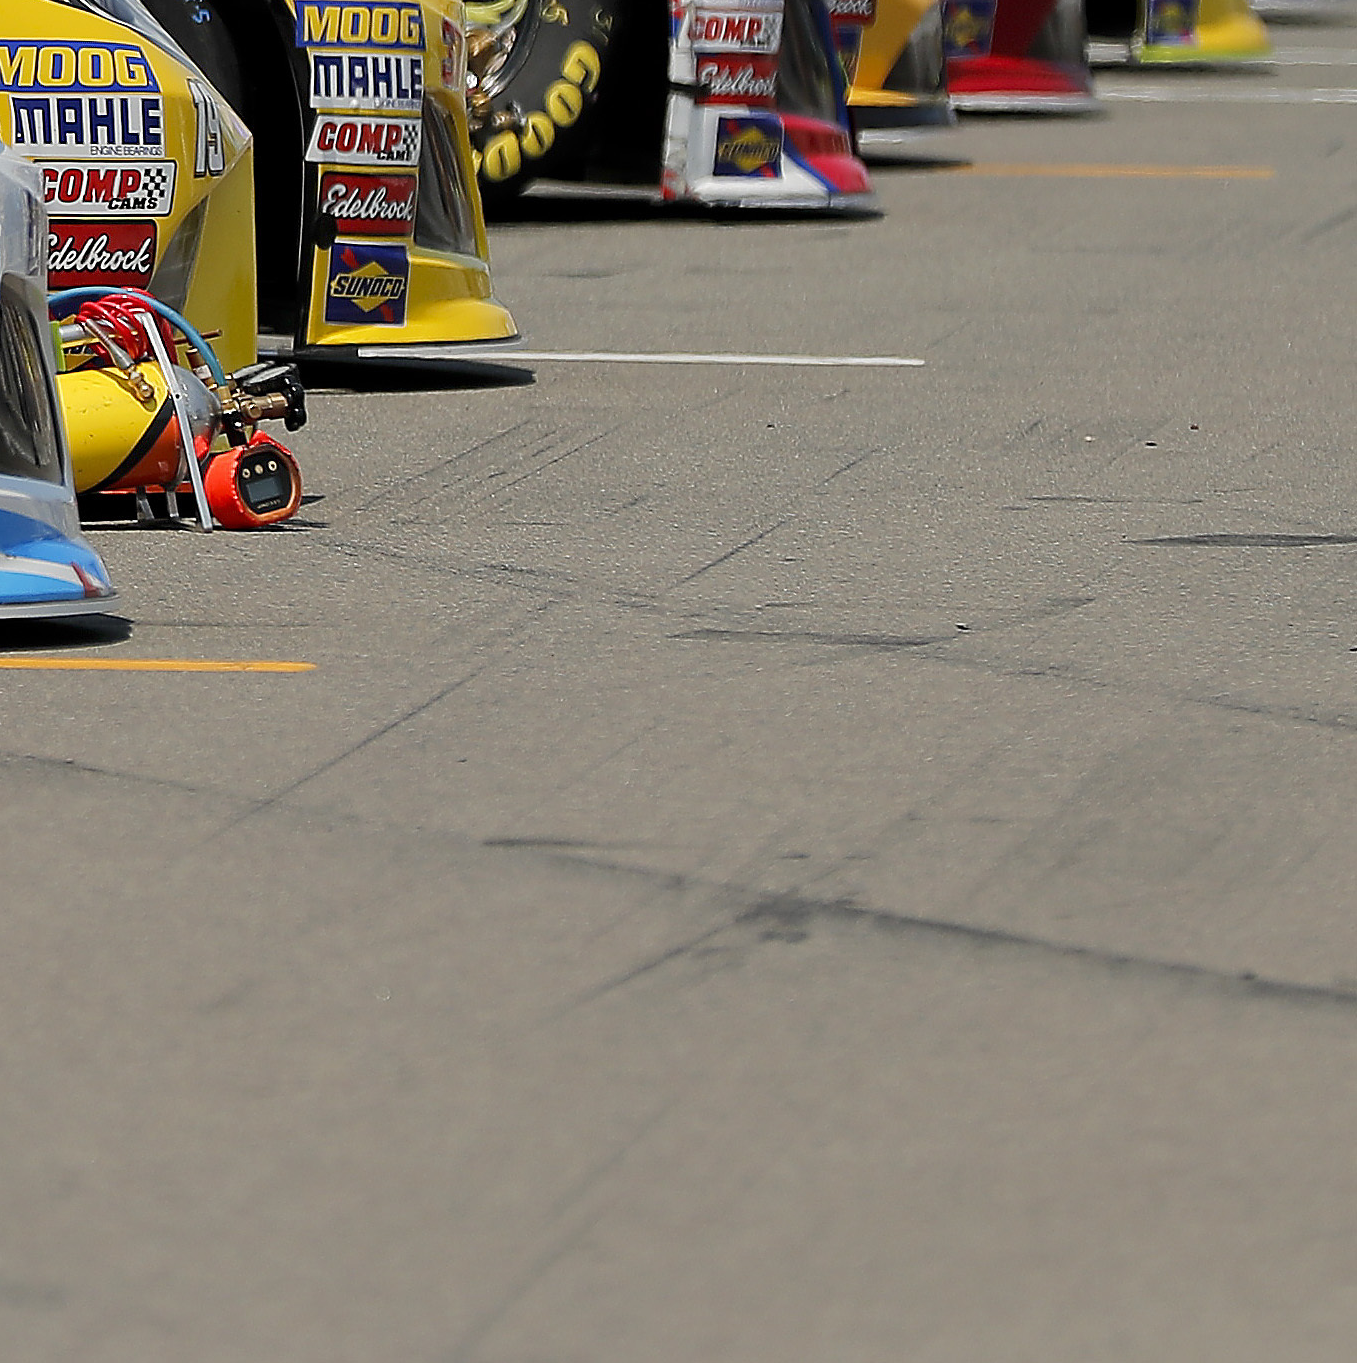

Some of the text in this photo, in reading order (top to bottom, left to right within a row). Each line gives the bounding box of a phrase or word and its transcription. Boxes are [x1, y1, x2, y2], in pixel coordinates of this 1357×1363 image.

[303, 4, 420, 46] MOOG
[313, 55, 423, 99] MAHLE
[12, 96, 164, 146] MAHLE
[187, 78, 226, 178] 19
[485, 38, 602, 183] GOOD
[90, 145, 124, 155] ENGINE
[317, 121, 403, 154] COMP
[43, 168, 143, 203] COMP
[107, 197, 159, 211] CAMS
[321, 183, 413, 221] Edelbrock
[333, 276, 405, 298] SUNOCO
